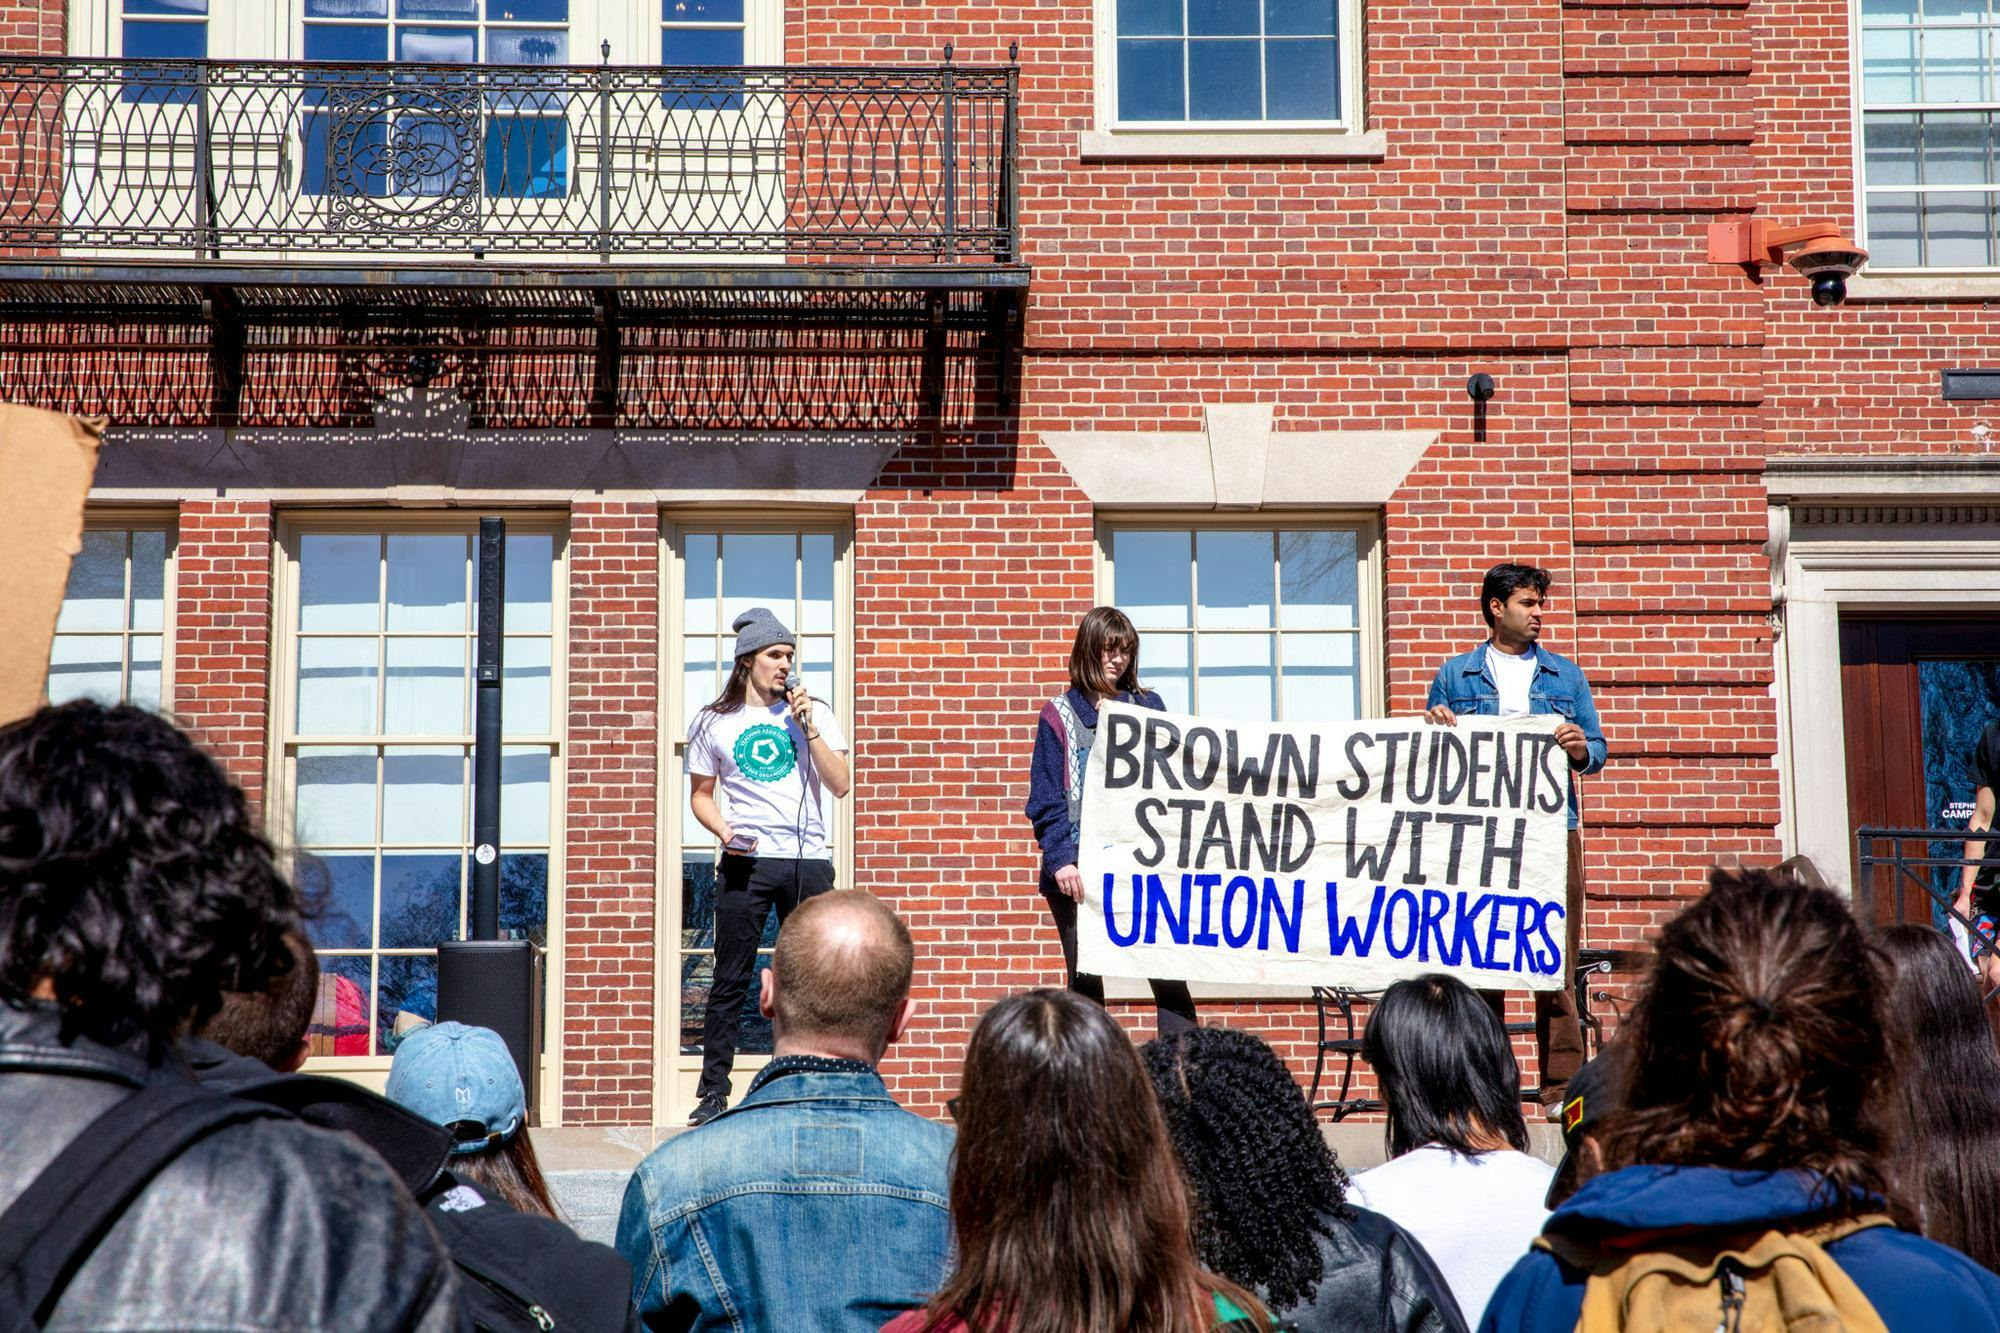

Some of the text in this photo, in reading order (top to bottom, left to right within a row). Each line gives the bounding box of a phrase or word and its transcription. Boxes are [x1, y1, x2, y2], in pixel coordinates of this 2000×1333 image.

[740, 728, 788, 746] TEACHING ASSISTANT
[1104, 713, 1566, 814] BROWN STUDENTS
[1132, 797, 1527, 890] STAND WITH
[1942, 809, 1976, 818] CAMP
[1103, 872, 1566, 975] UNION WORKERS
